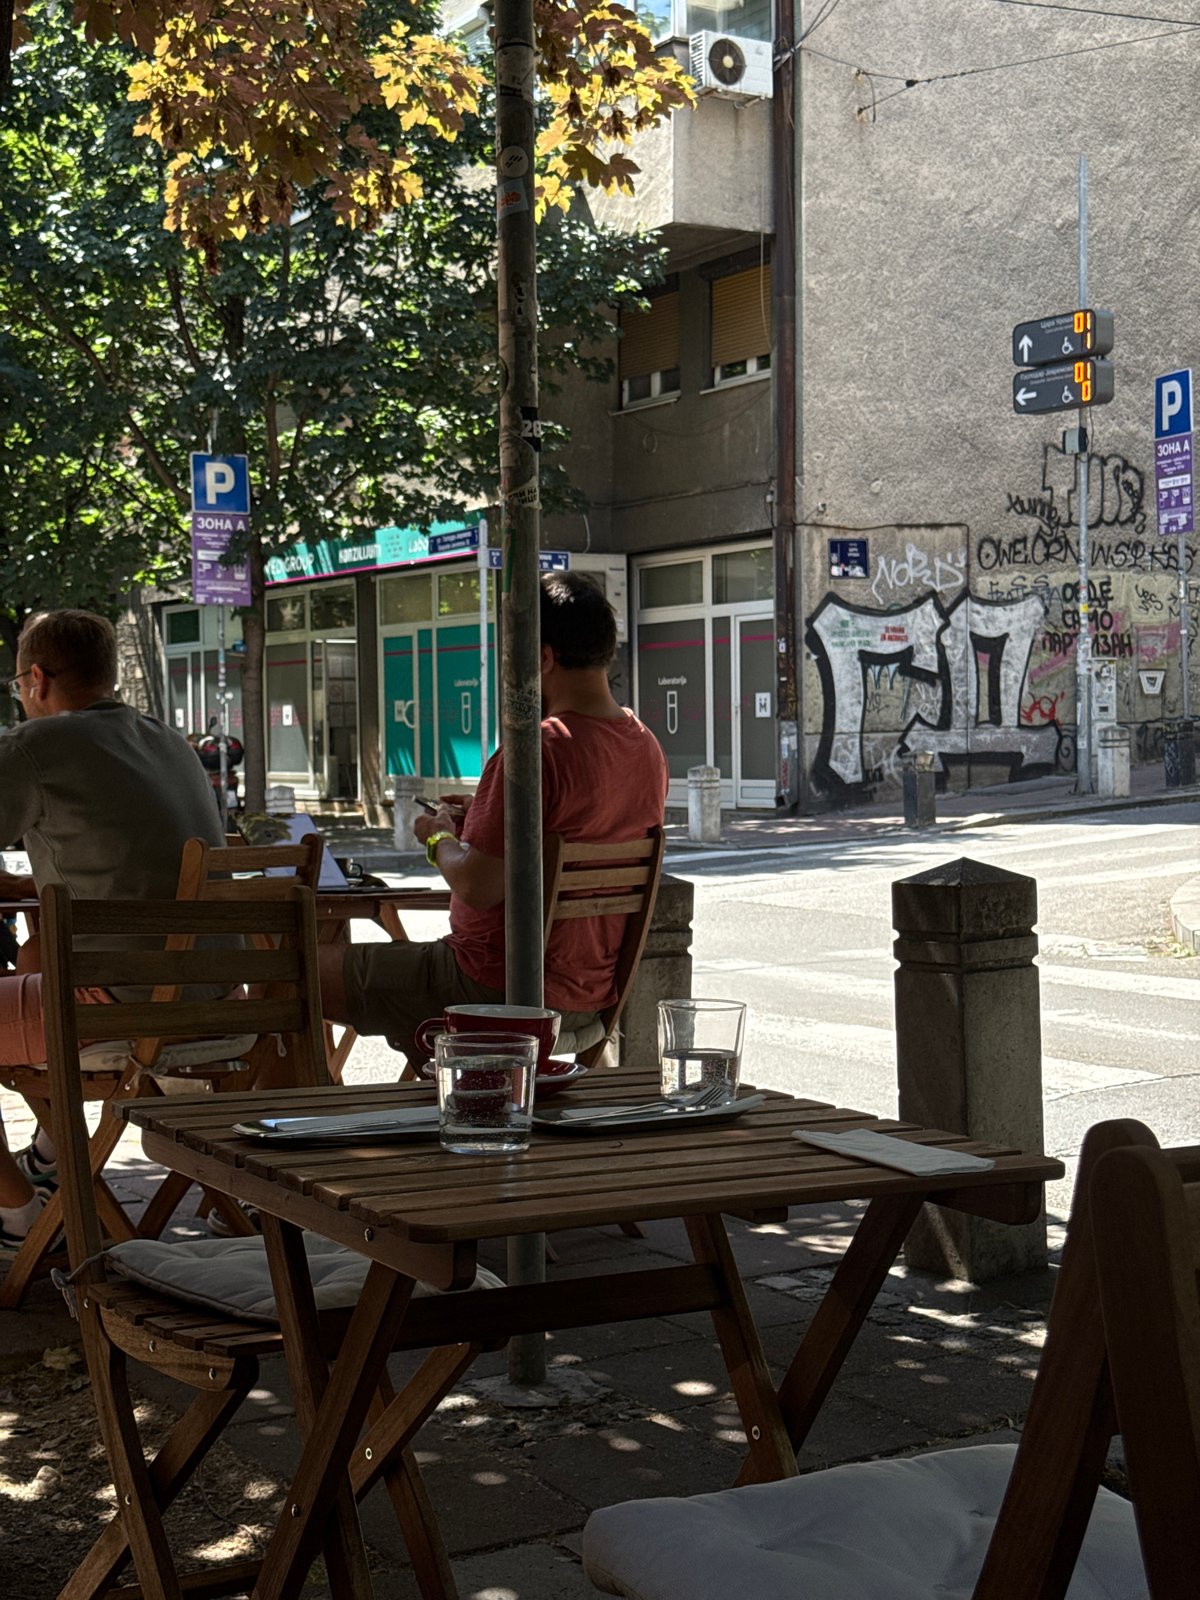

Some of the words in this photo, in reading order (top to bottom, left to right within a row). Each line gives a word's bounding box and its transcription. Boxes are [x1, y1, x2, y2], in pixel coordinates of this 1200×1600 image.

[1161, 379, 1183, 432] P
[1157, 440, 1181, 457] ЗОНА
[1182, 439, 1191, 453] А
[205, 461, 235, 505] P
[197, 517, 233, 531] ЗОНА
[236, 520, 246, 532] А
